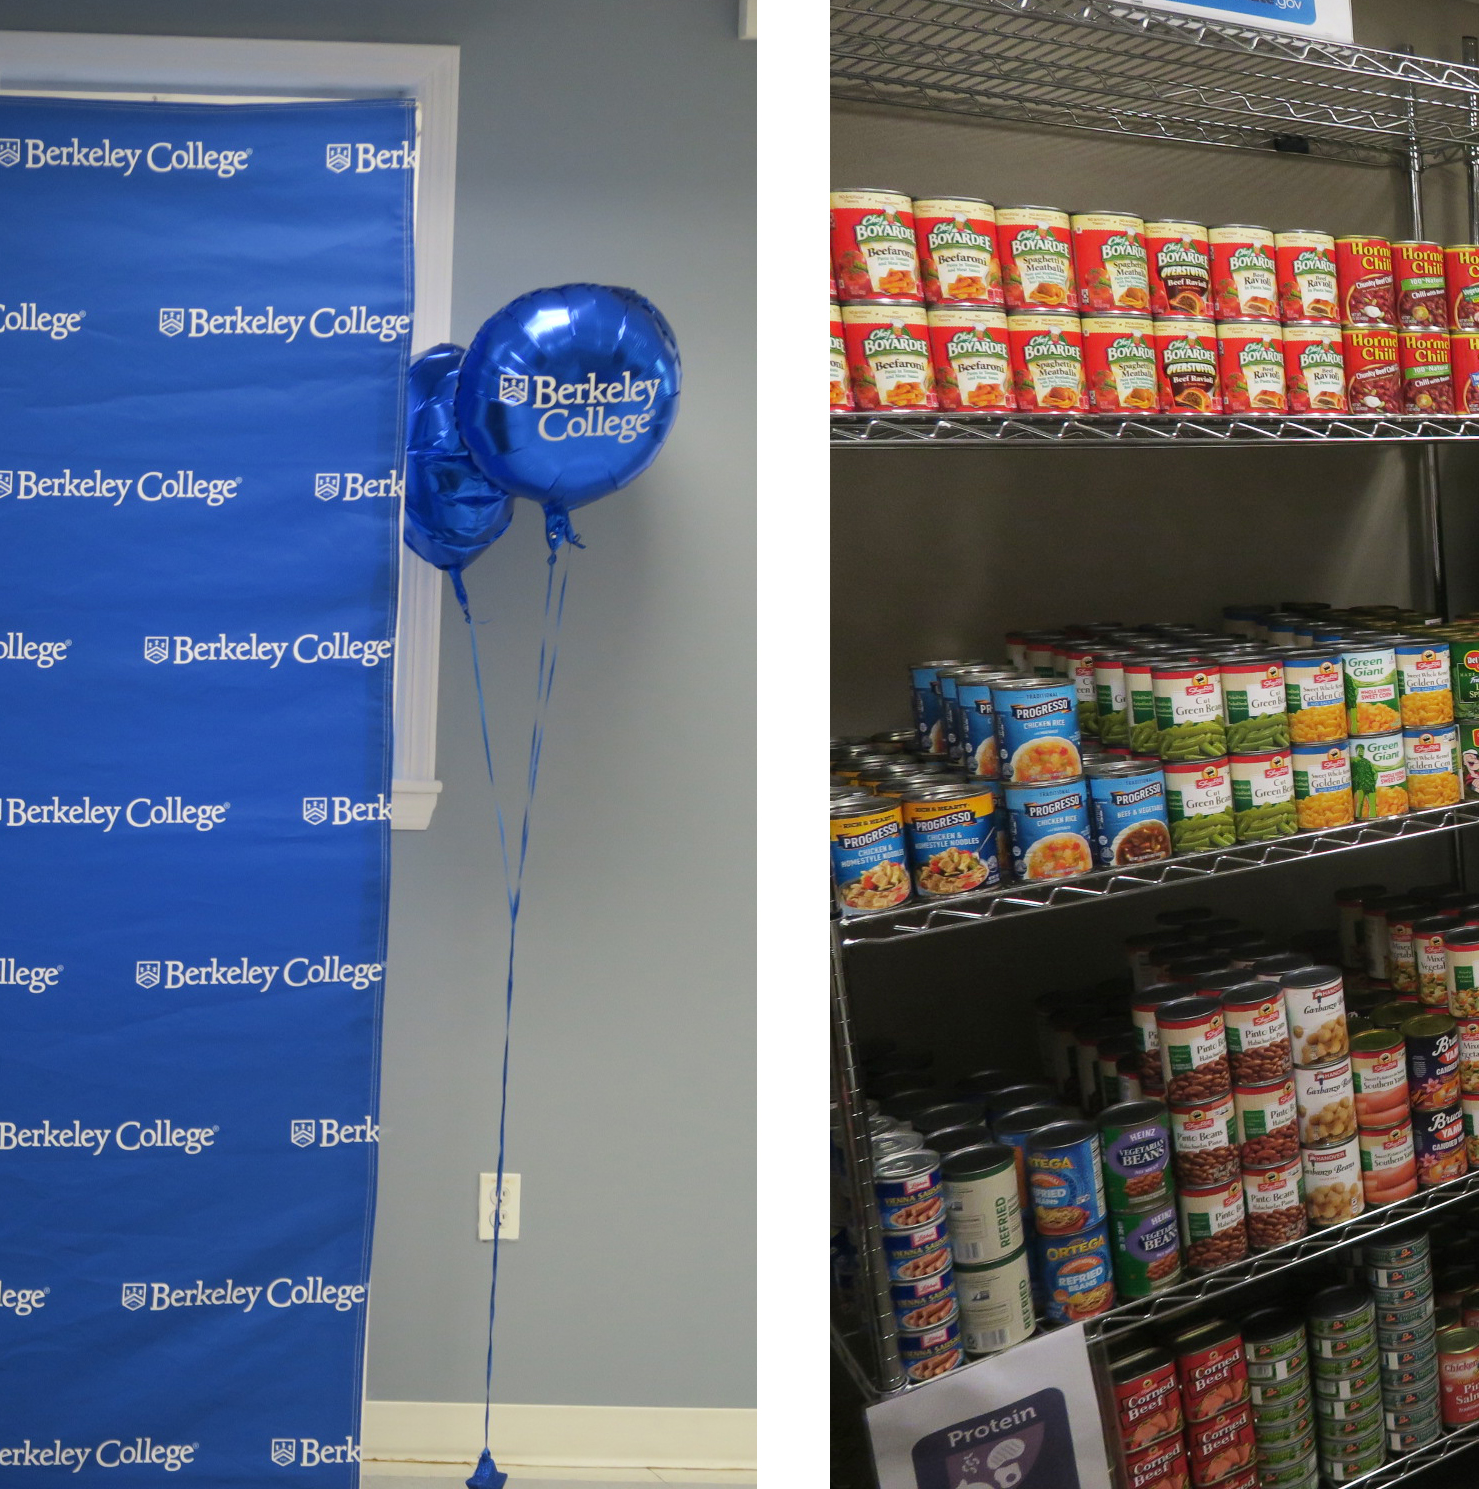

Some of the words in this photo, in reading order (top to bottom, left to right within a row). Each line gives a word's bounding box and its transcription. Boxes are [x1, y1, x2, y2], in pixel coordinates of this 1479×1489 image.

[24, 137, 143, 176] Berkeley
[861, 215, 883, 226] Chef
[933, 222, 954, 233] Chef
[856, 225, 916, 242] BOYARDEE
[929, 232, 992, 251] BOYARDEE
[868, 247, 914, 261] Beefaroni
[938, 254, 987, 267] Beefaroni
[188, 305, 306, 343] Berkeley
[864, 338, 928, 355] BOYARDEE
[948, 341, 1007, 358] BOYARDEE
[875, 361, 925, 372] Beefaroni
[958, 361, 1005, 374] Beefaroni
[532, 371, 660, 409] Berkeley
[17, 468, 134, 507] Berkeley
[173, 632, 289, 669] Berkeley
[1348, 658, 1382, 667] Green
[1353, 667, 1384, 677] Giant
[1016, 700, 1068, 719] PROGRESSO
[1023, 721, 1051, 730] CHICKEN
[1116, 784, 1161, 805] PROGRESSO
[6, 796, 122, 833] Berkeley
[1029, 796, 1079, 817] PROGRESSO
[916, 811, 971, 832] PROGRESSO
[843, 822, 898, 848] PROGRESSO
[164, 957, 280, 993] Berkeley
[1129, 1128, 1155, 1142] HEINZ
[1199, 1129, 1223, 1141] Beans
[1119, 1138, 1165, 1156] VEGETARIAN
[1122, 1147, 1165, 1167] BEANS
[1000, 1196, 1008, 1248] REFRIED
[1046, 1235, 1106, 1261] ORTEGA
[1058, 1267, 1103, 1286] REFRIED
[150, 1279, 263, 1313] Berkeley
[1195, 1350, 1240, 1379] Corned
[1195, 1367, 1230, 1392] Beef
[1127, 1377, 1174, 1409] Corned
[1128, 1396, 1163, 1421] Beef
[947, 1405, 1037, 1448] Protein
